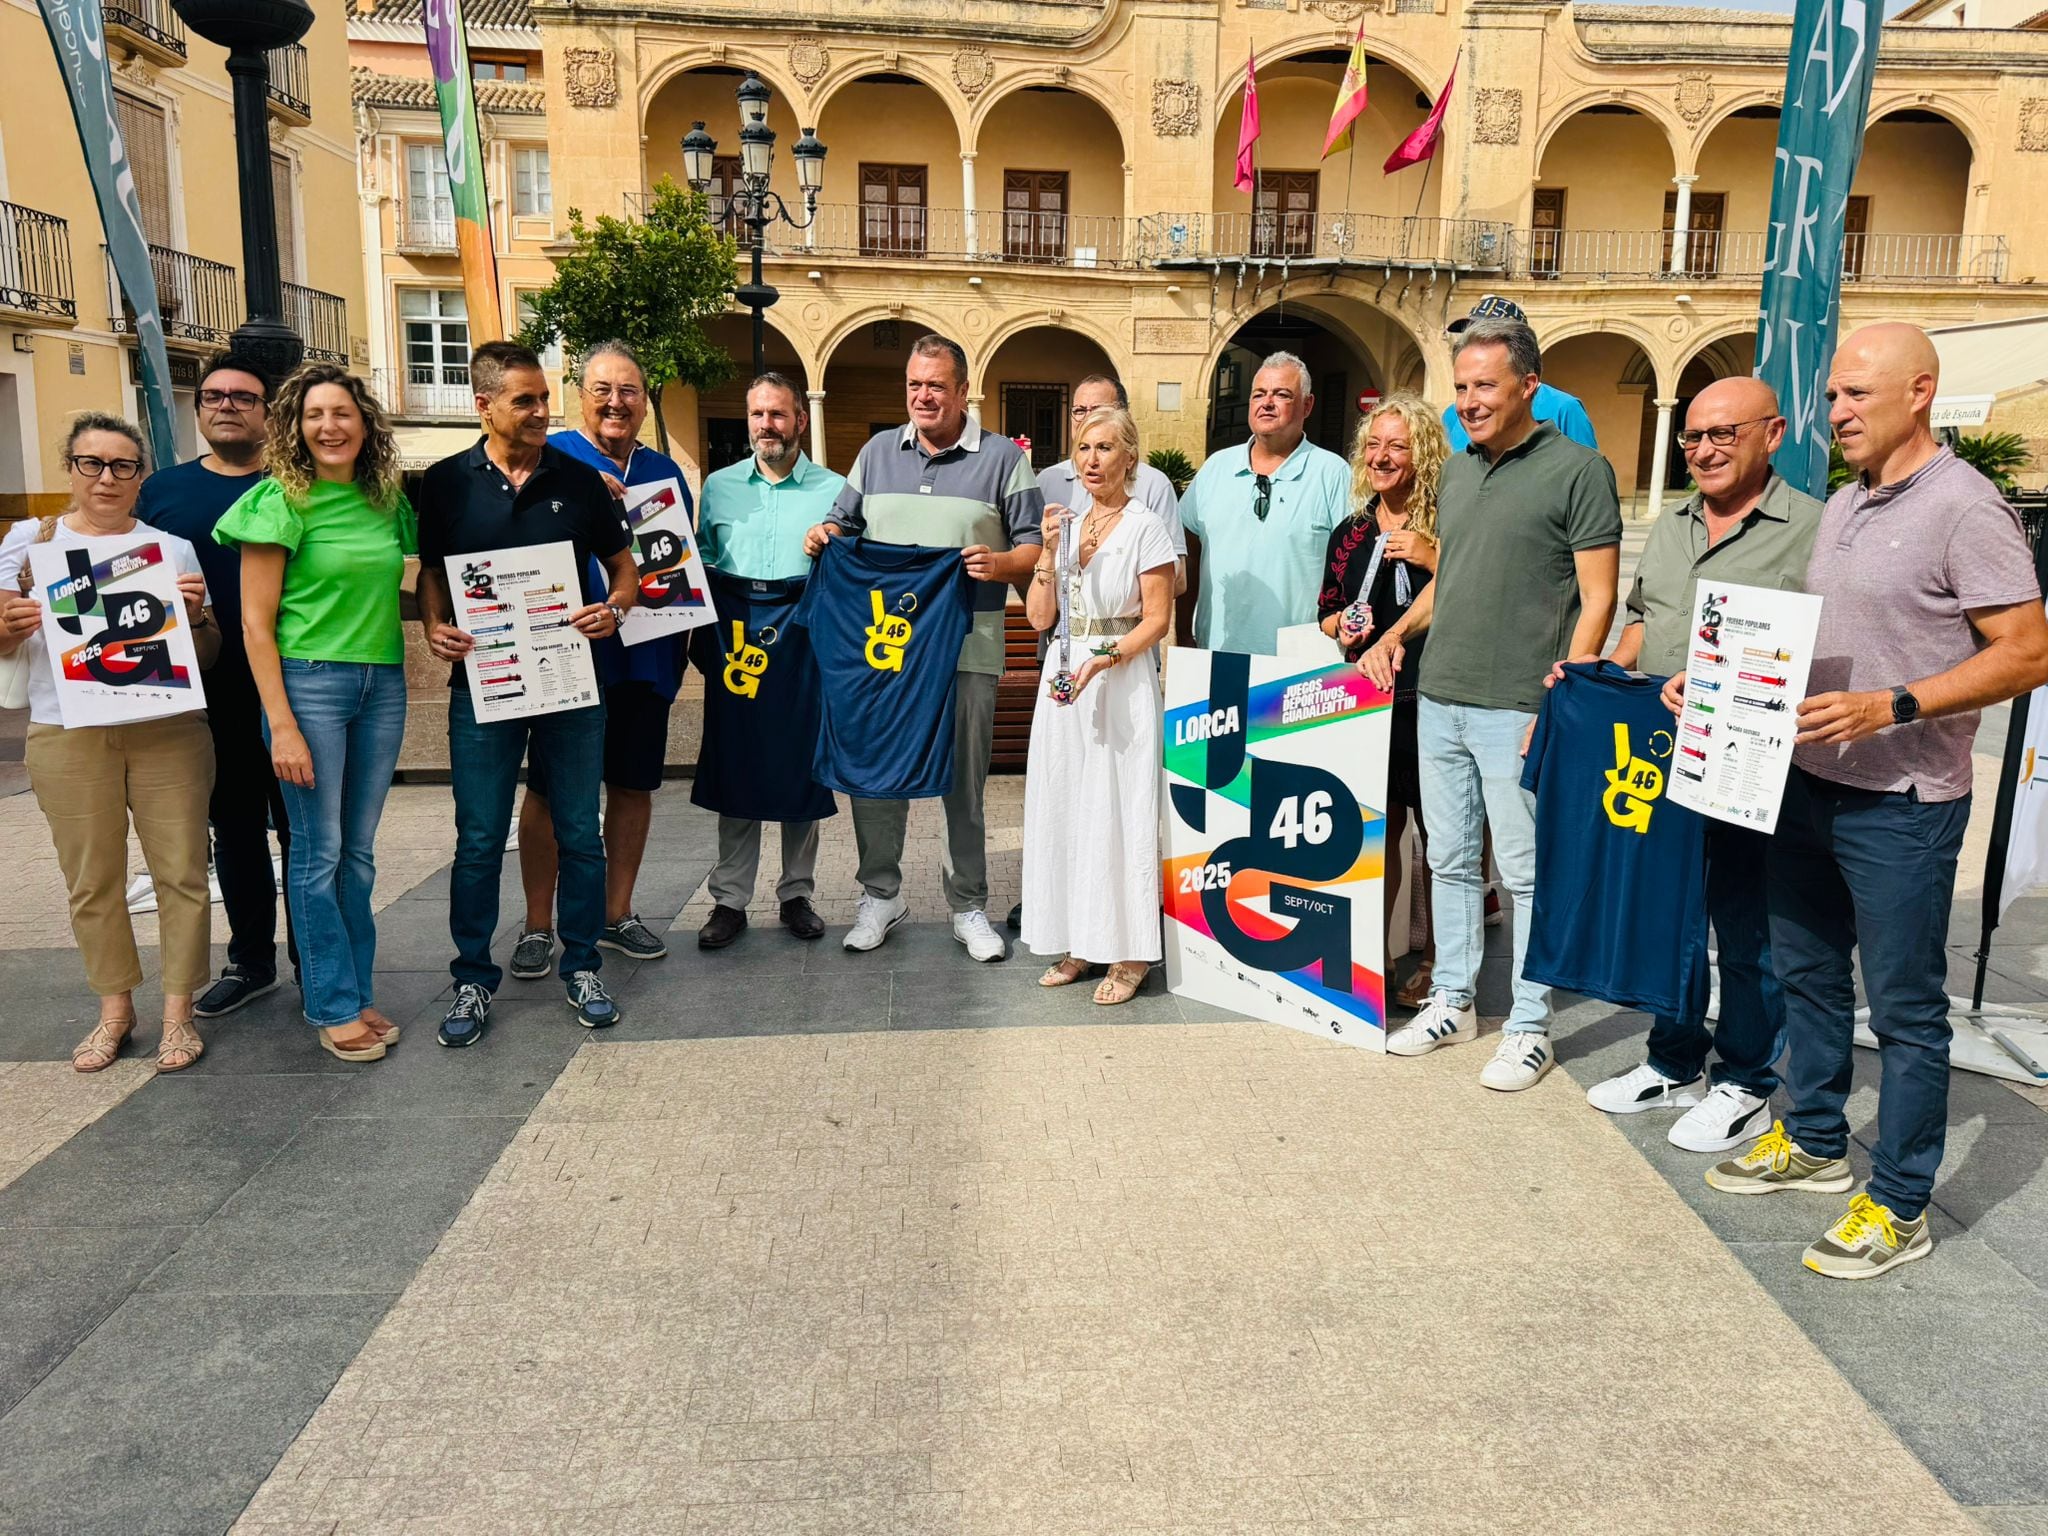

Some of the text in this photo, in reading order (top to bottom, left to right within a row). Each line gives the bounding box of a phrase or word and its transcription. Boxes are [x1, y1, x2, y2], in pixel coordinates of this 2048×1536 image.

[396, 460, 437, 469] TAURAN
[650, 536, 673, 561] 46
[54, 575, 91, 601] LORCA
[118, 599, 151, 629] 46
[886, 622, 907, 639] 46
[71, 643, 103, 667] 2025
[744, 653, 764, 667] 46
[1283, 678, 1323, 699] JUEGOS
[1175, 705, 1240, 746] LORCA
[1631, 770, 1657, 790] 46
[1269, 790, 1333, 849] 46
[1179, 861, 1232, 895] 2025
[1284, 894, 1334, 915] SEPT/OCT
